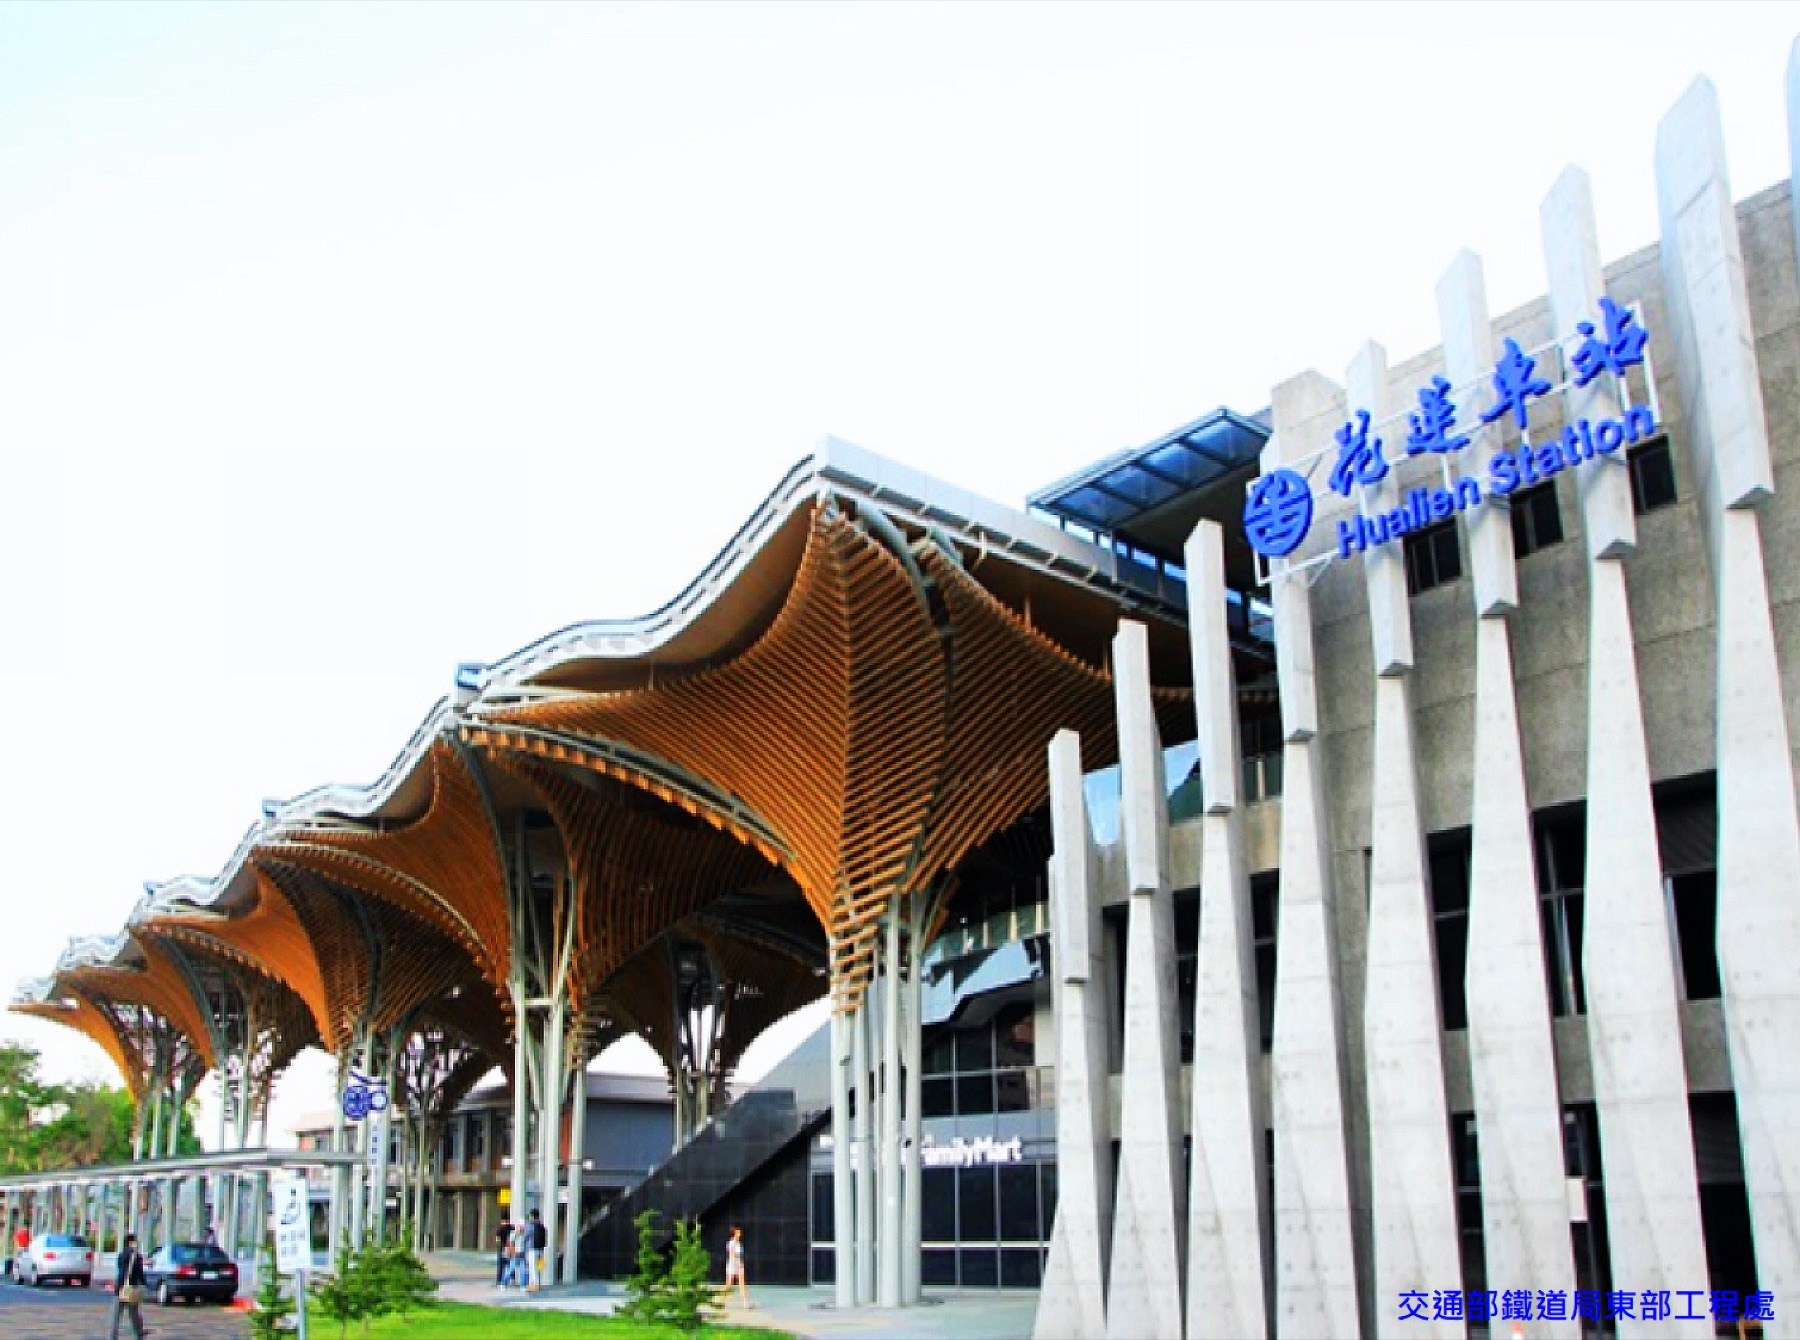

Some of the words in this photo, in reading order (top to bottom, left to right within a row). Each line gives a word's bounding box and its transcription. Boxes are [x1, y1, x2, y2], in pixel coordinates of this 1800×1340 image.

[1328, 296, 1650, 498] 花蓮車站
[1338, 476, 1482, 559] Hualien
[1490, 404, 1656, 496] Station
